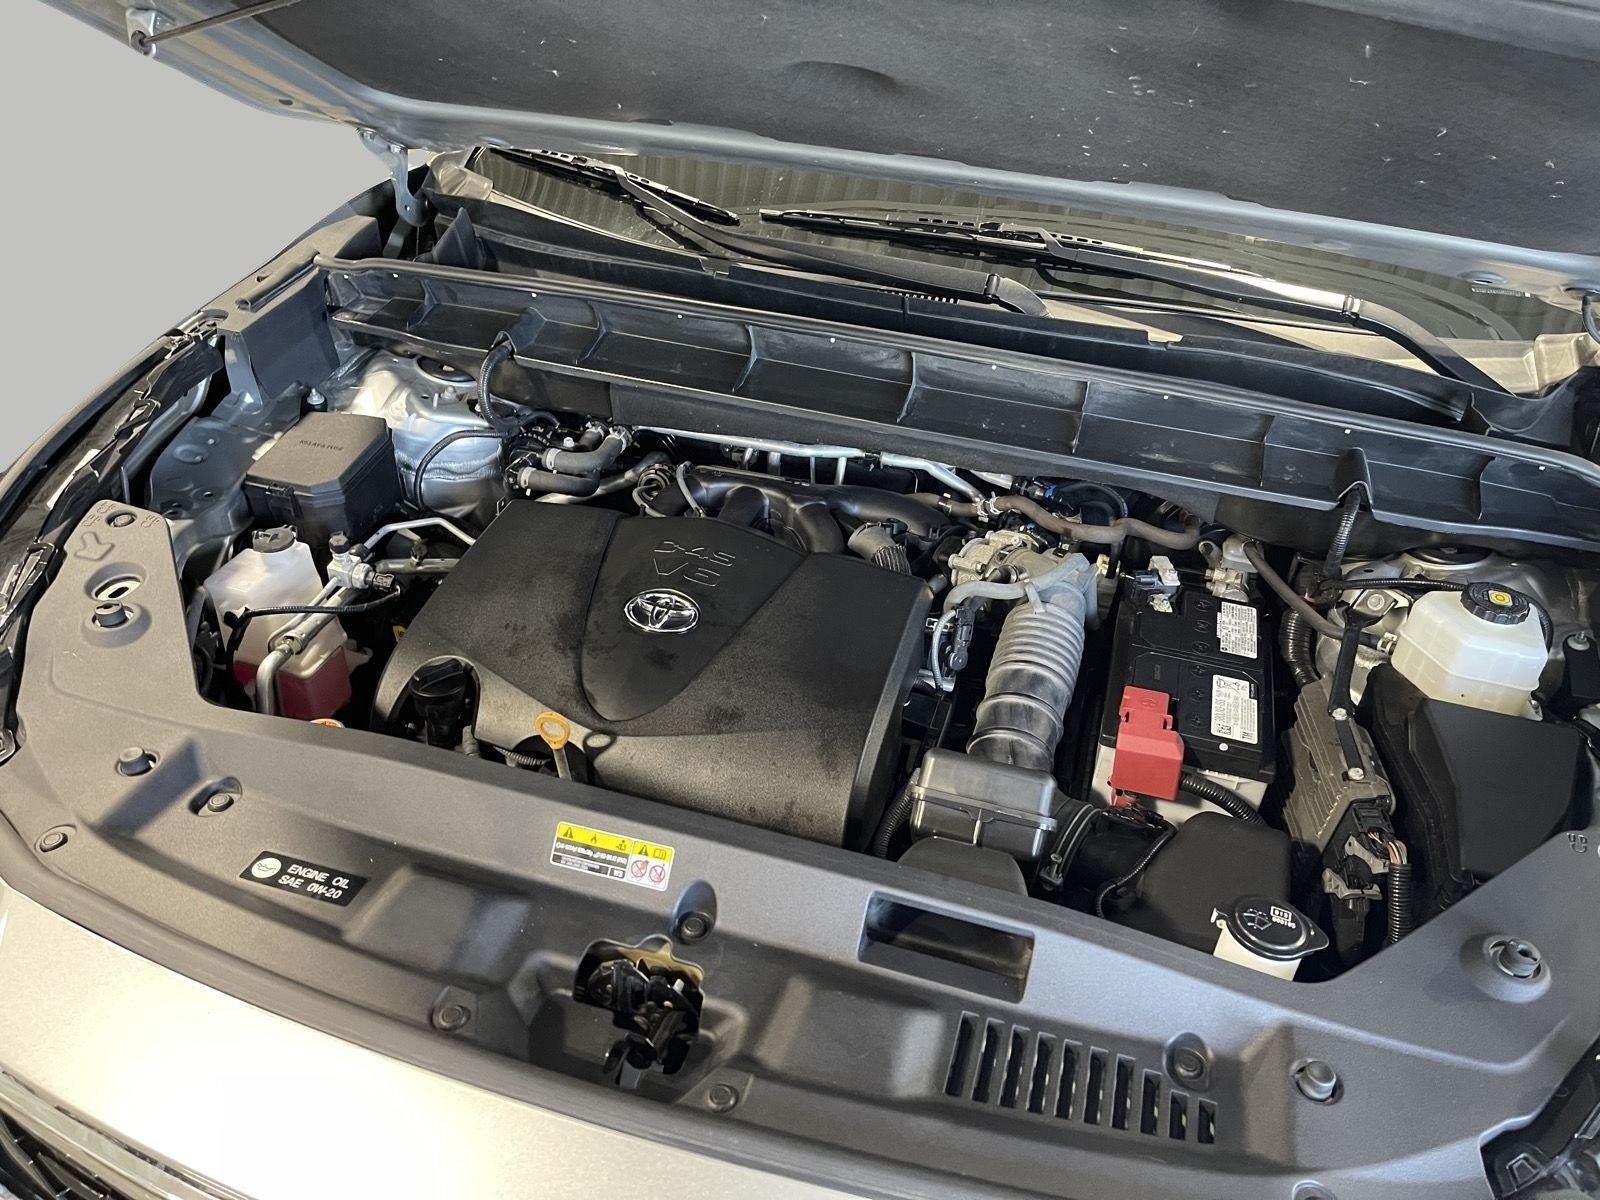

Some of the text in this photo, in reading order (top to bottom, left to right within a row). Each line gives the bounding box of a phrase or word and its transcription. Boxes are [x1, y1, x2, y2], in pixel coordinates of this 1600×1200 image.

[653, 557, 722, 587] V6
[278, 874, 343, 899] SAE 0W-20
[287, 864, 350, 889] ENGINE OIL
